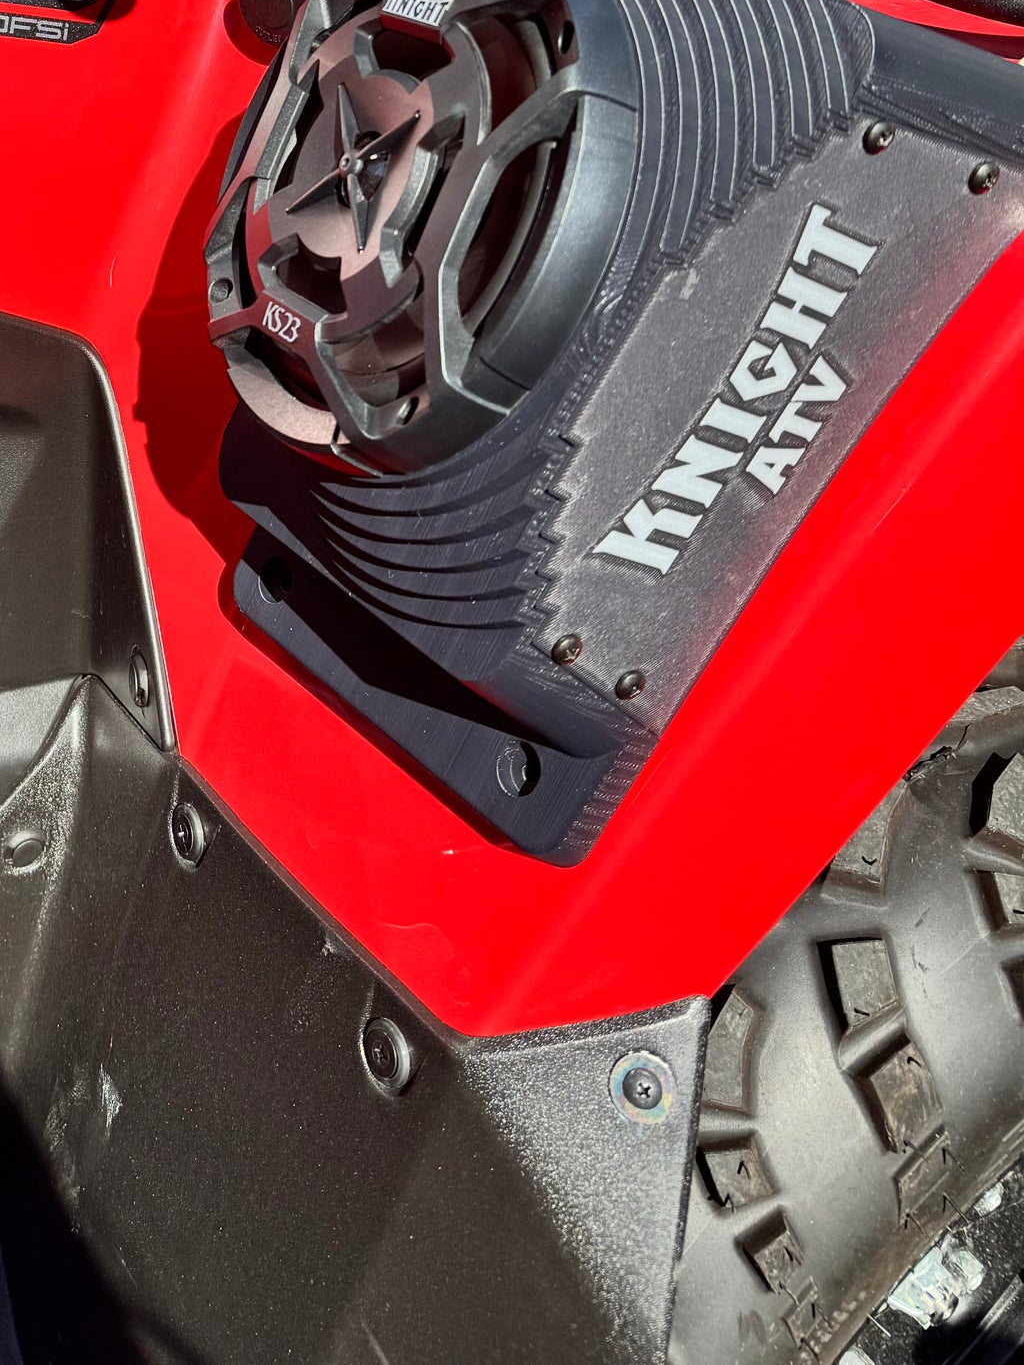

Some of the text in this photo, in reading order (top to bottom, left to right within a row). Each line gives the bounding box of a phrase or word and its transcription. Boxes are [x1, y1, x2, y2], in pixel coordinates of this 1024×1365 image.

[262, 301, 302, 342] KS23
[591, 204, 879, 575] KNIGHT
[745, 355, 849, 495] ATV
